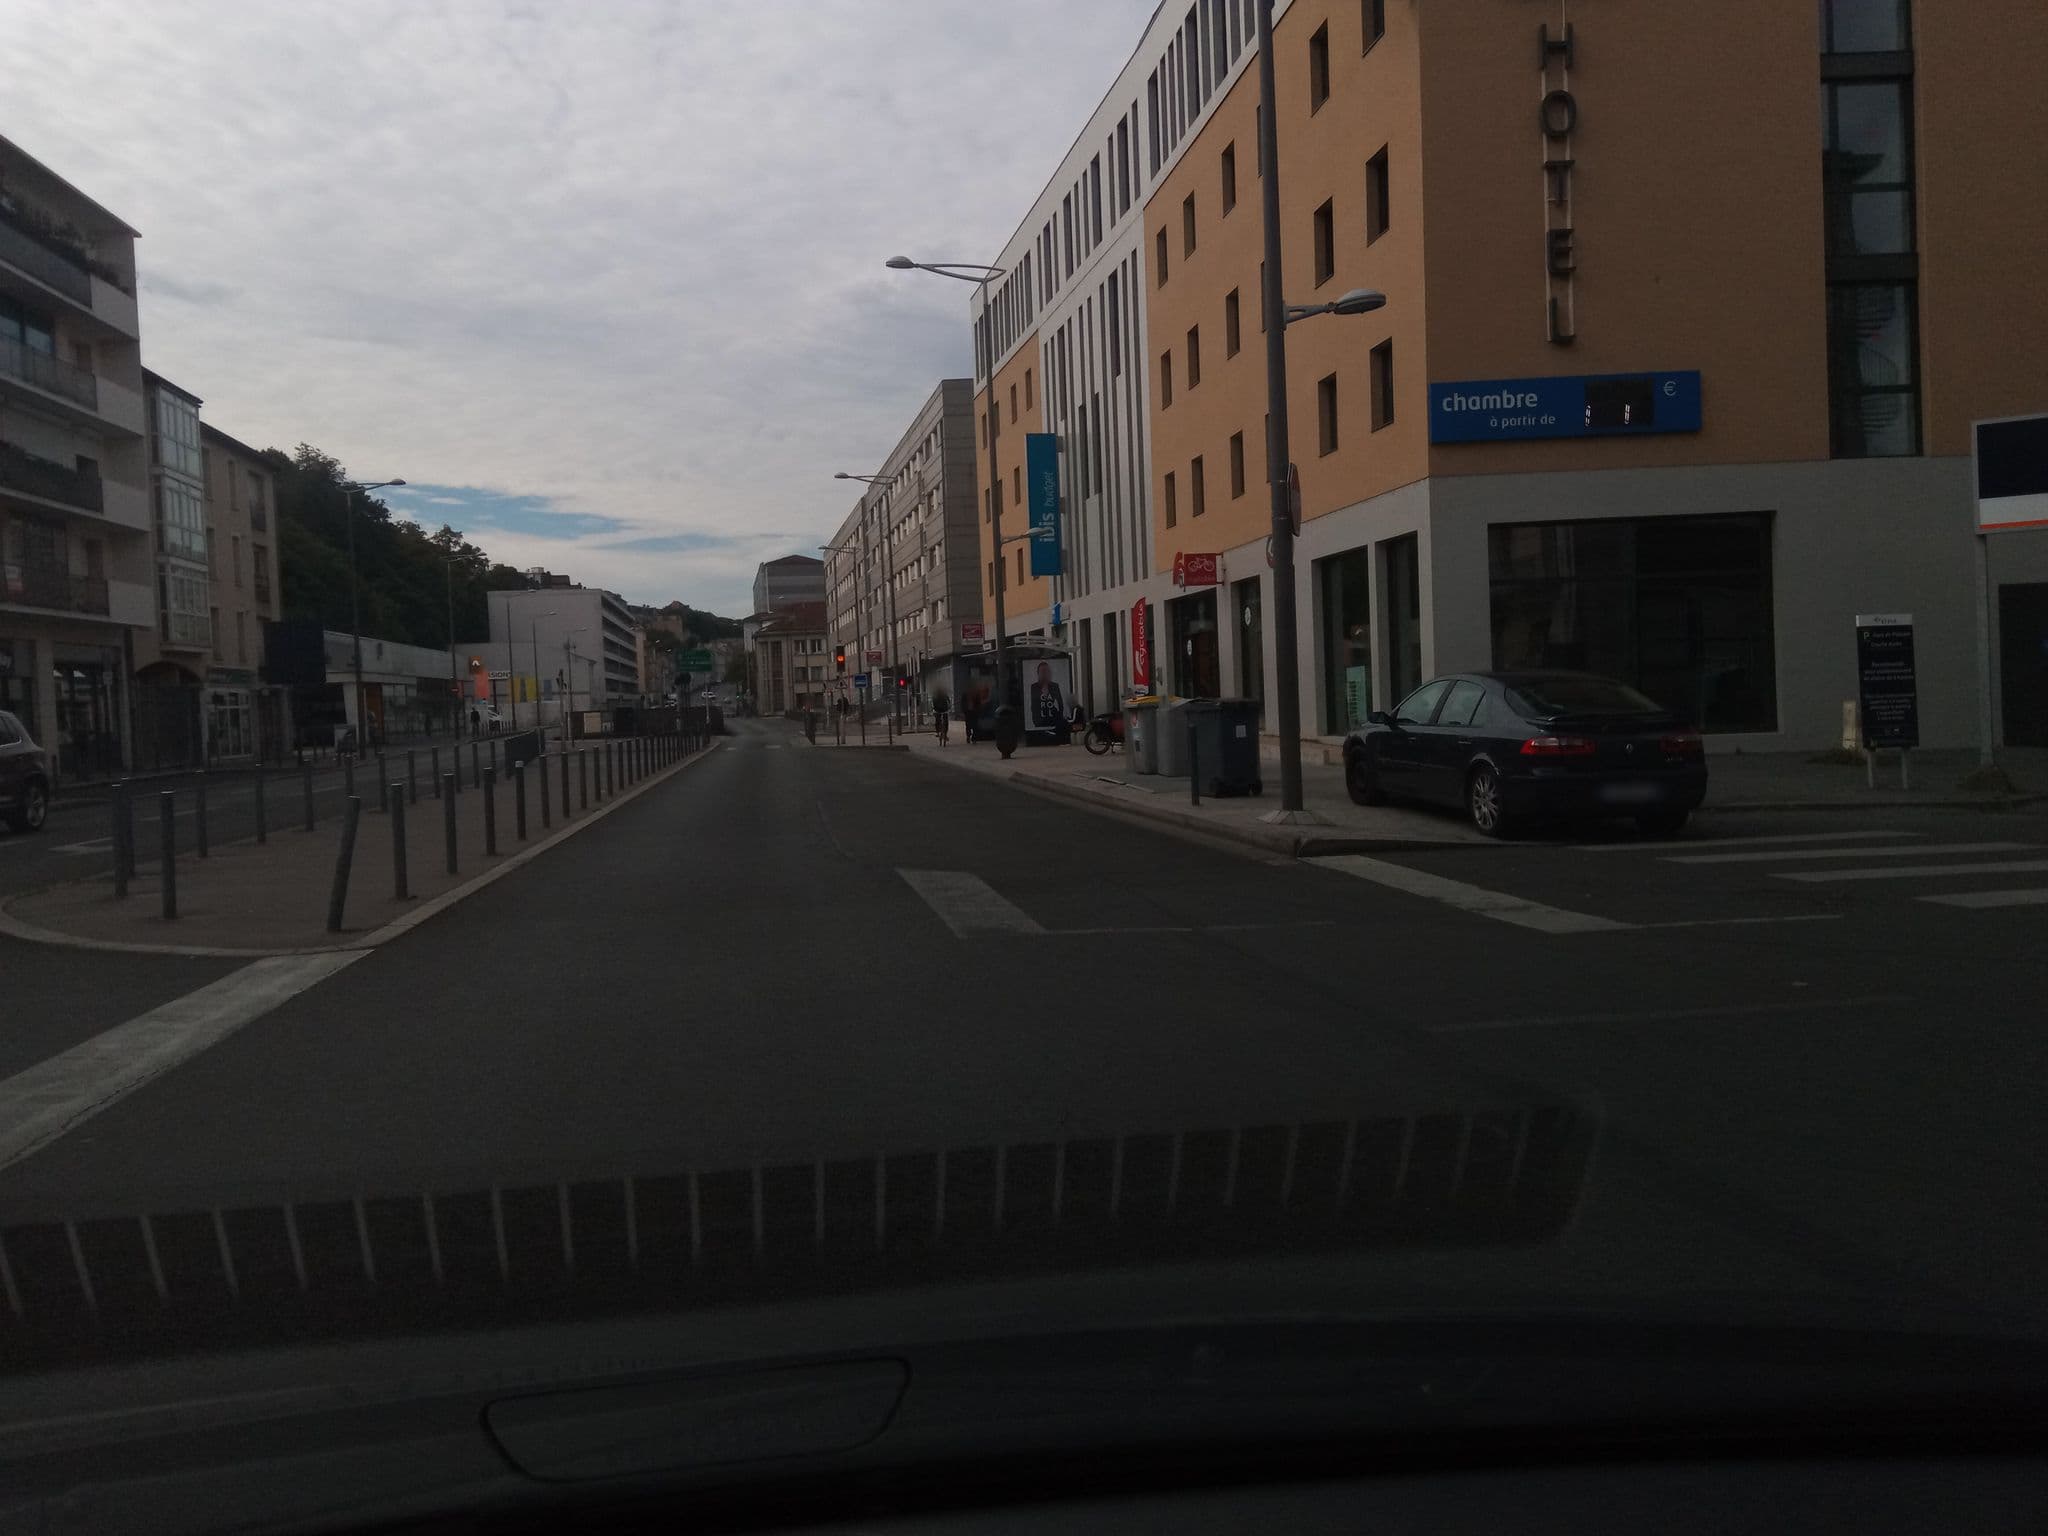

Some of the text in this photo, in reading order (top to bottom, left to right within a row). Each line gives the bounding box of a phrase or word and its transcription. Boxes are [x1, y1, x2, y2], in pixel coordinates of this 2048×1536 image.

[1538, 23, 1577, 346] HOTEL
[1441, 380, 1677, 413] chambre €
[1501, 414, 1537, 430] partir
[1539, 413, 1556, 426] de
[1043, 471, 1056, 507] budget
